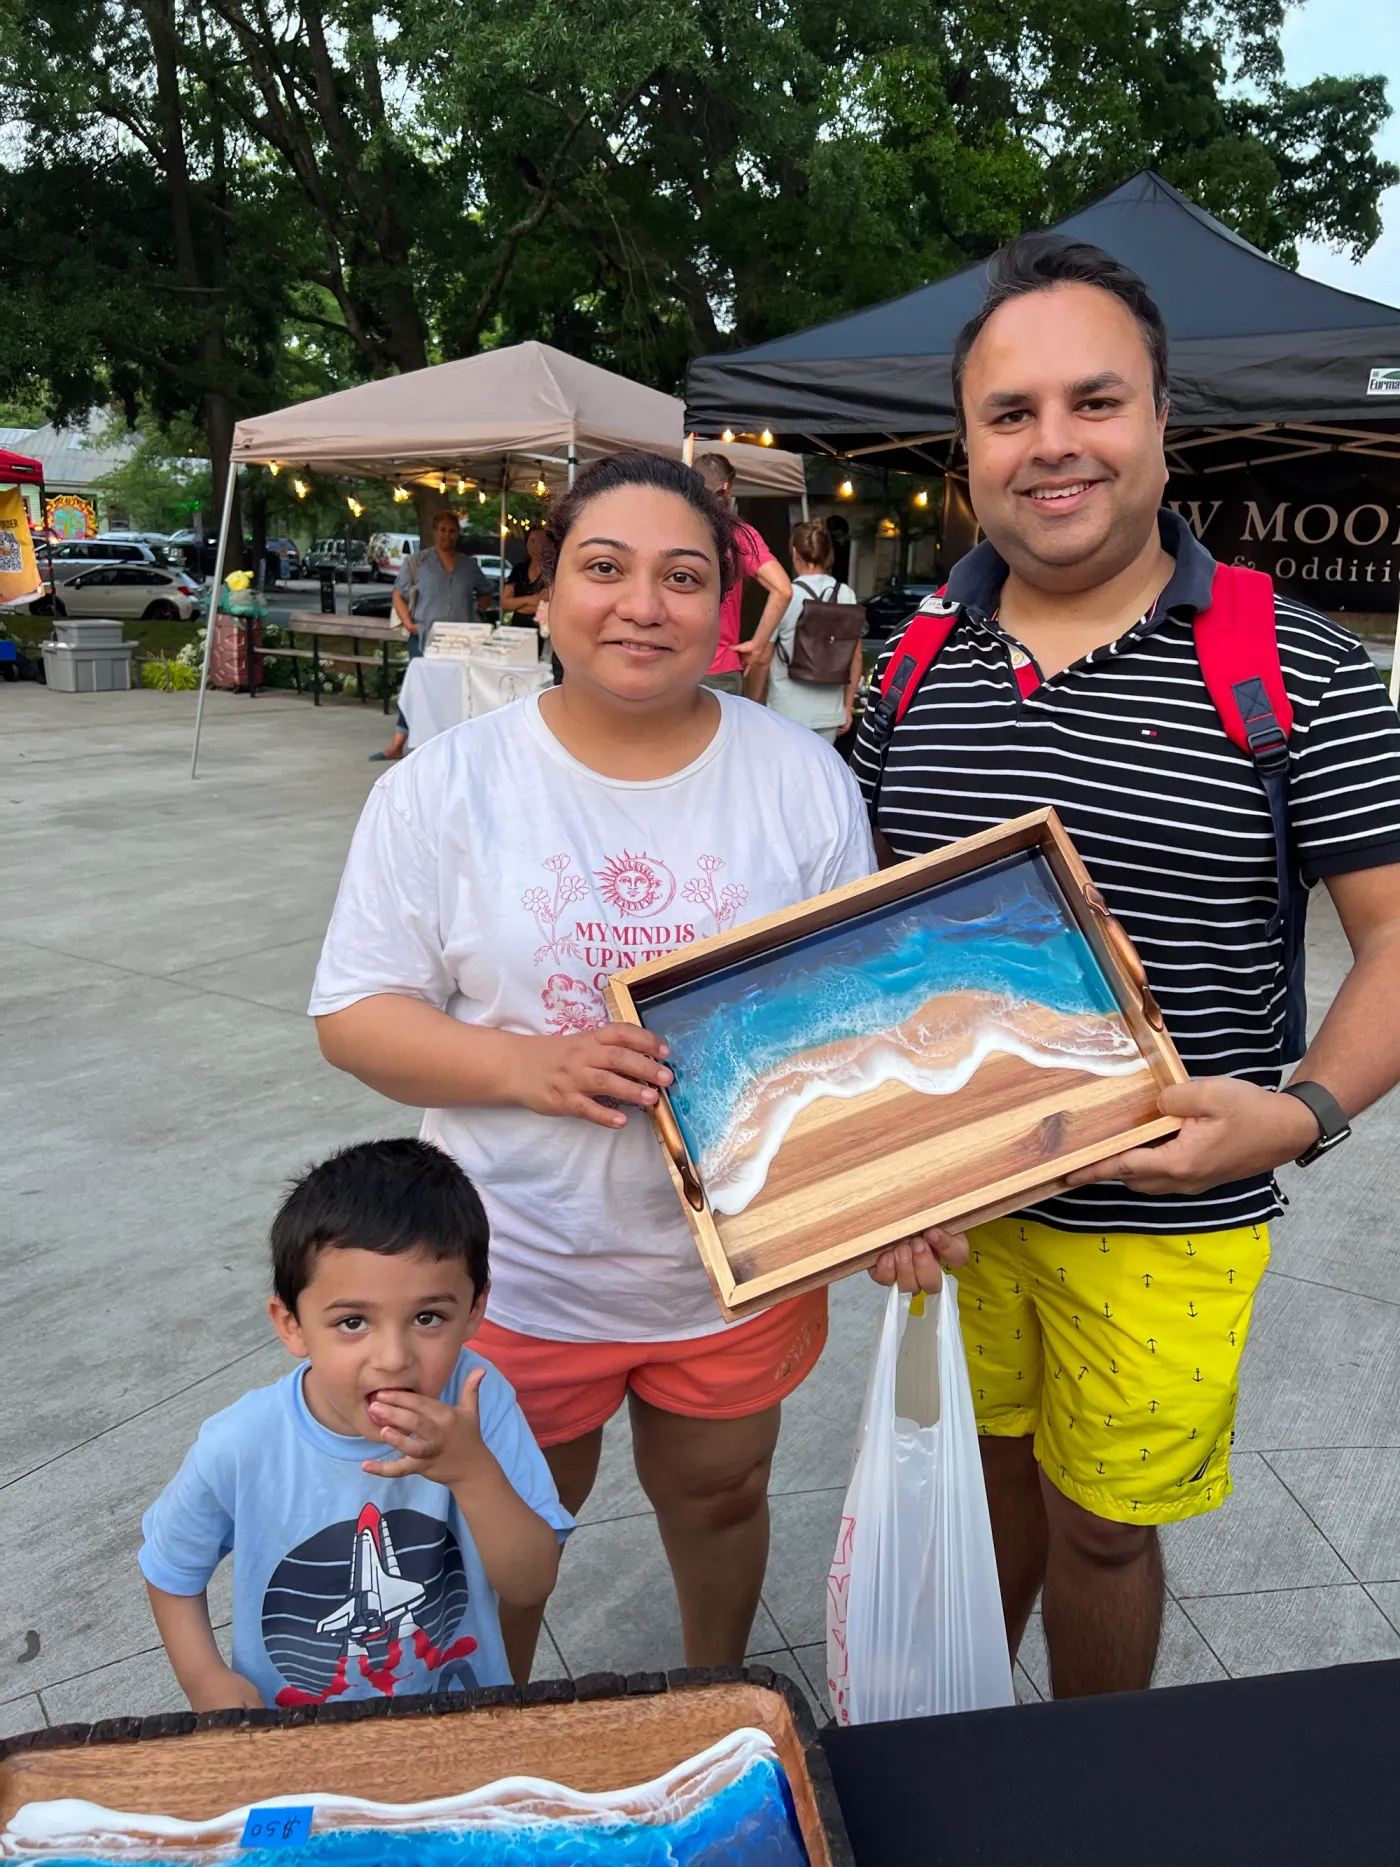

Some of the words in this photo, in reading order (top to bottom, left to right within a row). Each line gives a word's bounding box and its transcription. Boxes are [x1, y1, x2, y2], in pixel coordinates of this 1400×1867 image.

[1240, 501, 1400, 546] MOO
[1275, 557, 1400, 583] Odditi
[575, 922, 608, 942] MY
[612, 925, 671, 946] MIND
[674, 923, 695, 943] IS
[584, 947, 613, 968] UP
[616, 949, 636, 969] IN
[251, 1815, 301, 1840] $50
